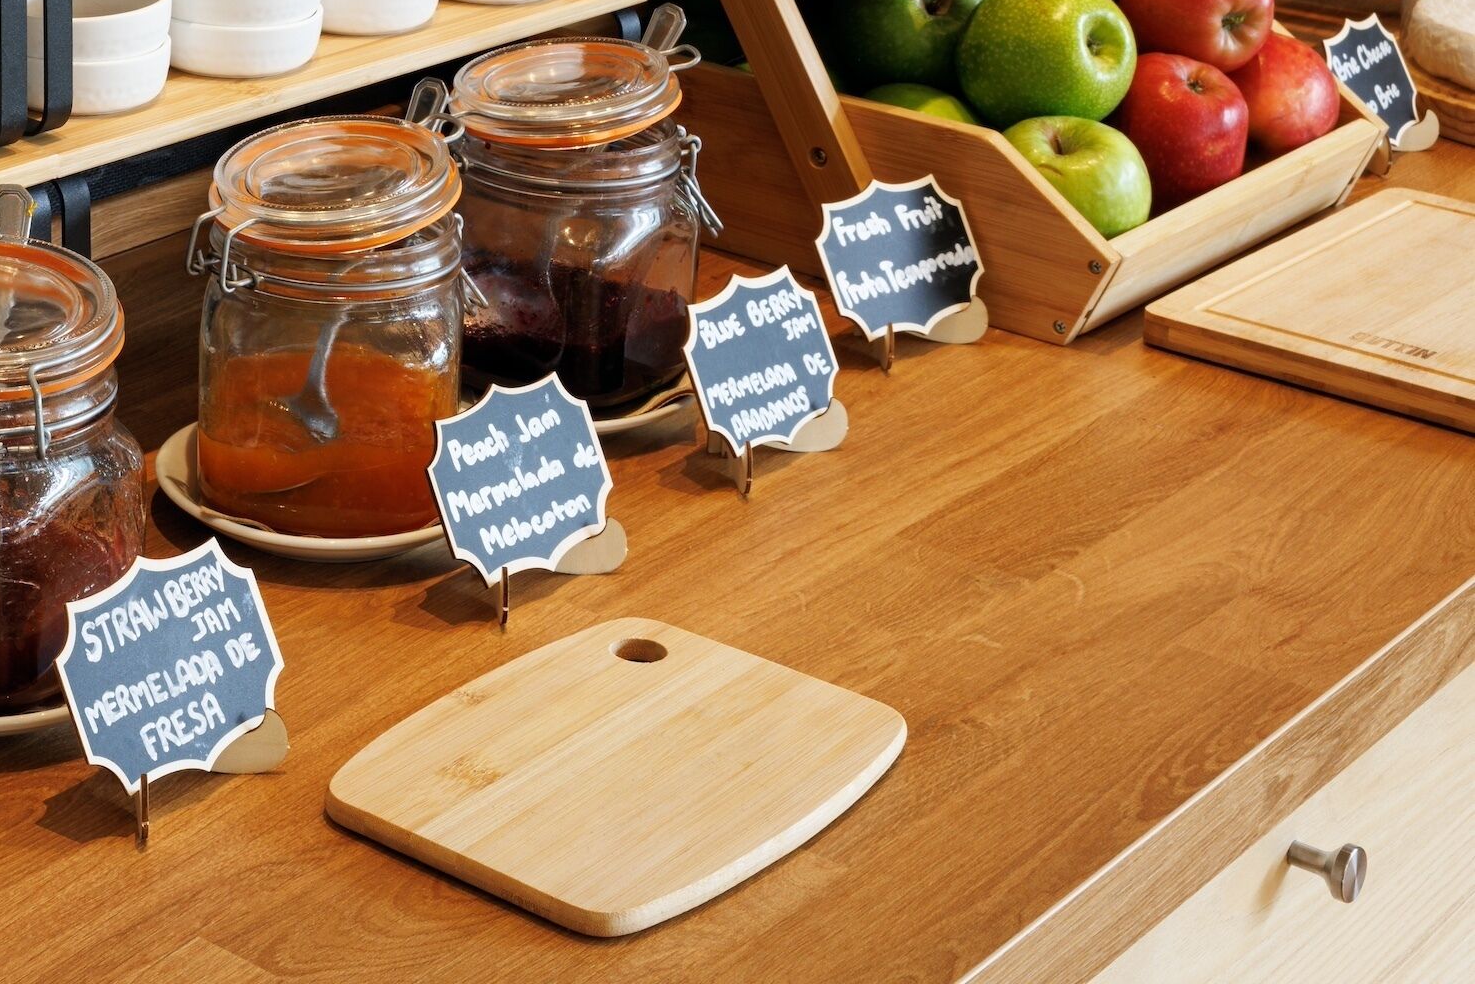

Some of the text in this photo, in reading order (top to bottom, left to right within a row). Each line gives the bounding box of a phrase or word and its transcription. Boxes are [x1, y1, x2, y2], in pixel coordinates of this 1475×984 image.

[1332, 53, 1360, 82] Brie
[1374, 83, 1401, 110] Brie
[698, 288, 804, 350] BLUE BERRY
[781, 312, 818, 341] JAM
[706, 352, 831, 410] MERMELADA DE
[447, 409, 561, 472] Peach Jam
[446, 442, 599, 523] Mermelada de
[479, 494, 592, 556] Melocoton
[190, 597, 241, 642] JAM
[85, 632, 261, 735] MERMELADA DE
[139, 690, 226, 762] FRESA
